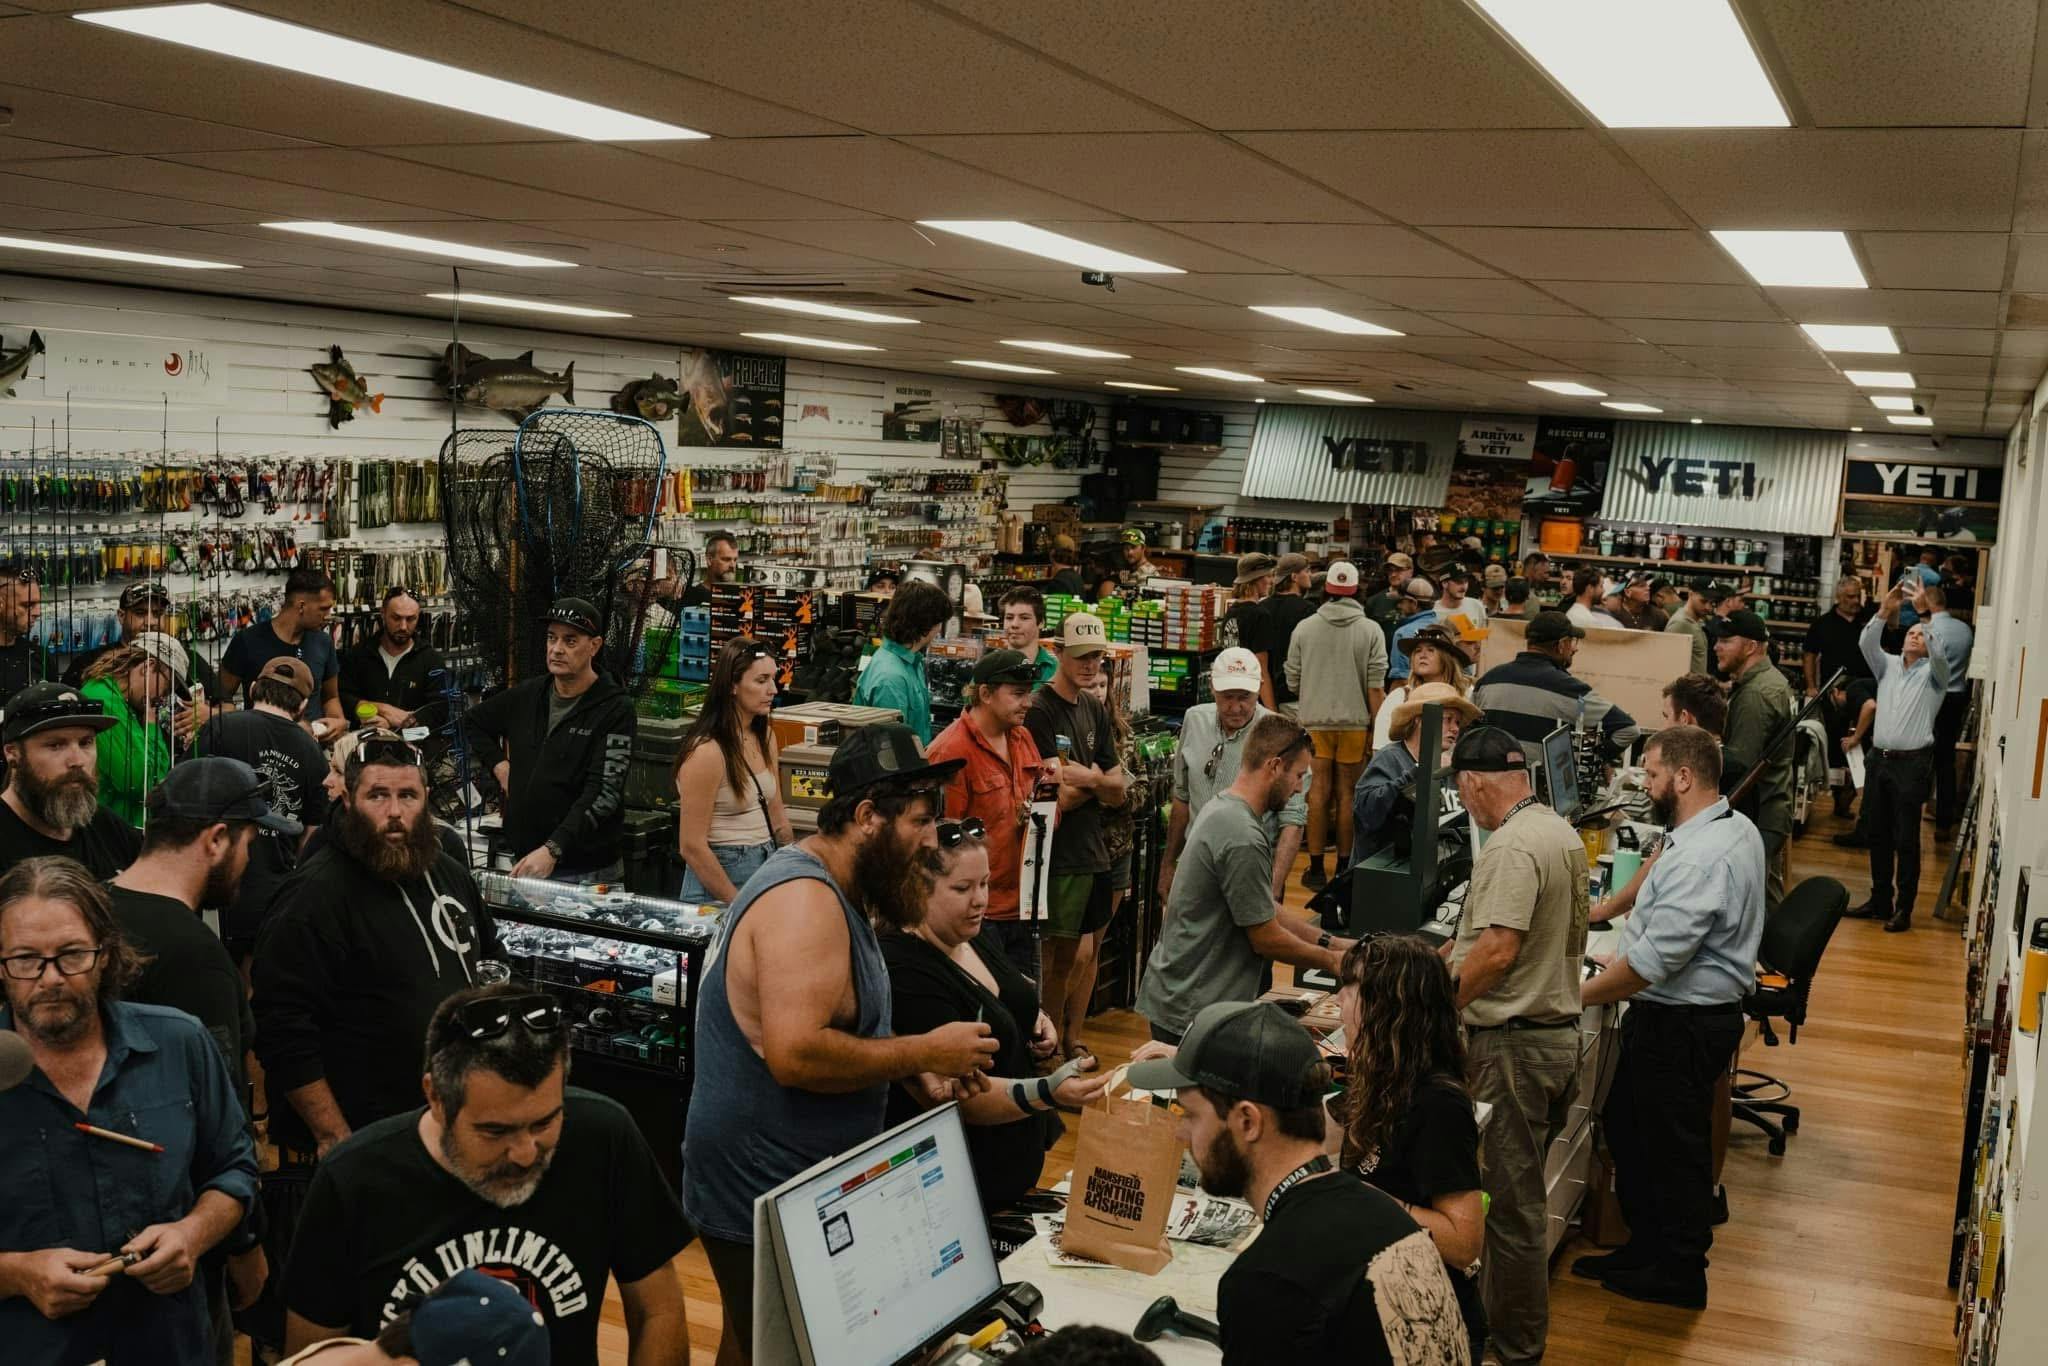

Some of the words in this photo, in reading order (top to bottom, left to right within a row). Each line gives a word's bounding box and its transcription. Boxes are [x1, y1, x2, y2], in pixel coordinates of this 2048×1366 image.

[1471, 430, 1525, 442] ARRIVAL
[1547, 429, 1584, 438] RESCUE
[1322, 435, 1426, 475] YETI
[1480, 445, 1511, 455] YETI
[1640, 456, 1756, 500] YETI
[1875, 463, 1979, 499] YETI
[1075, 623, 1102, 636] CTC
[1087, 1175, 1146, 1207] HUNTING
[1094, 1166, 1142, 1190] MANSFIELD
[1278, 1166, 1309, 1193] EVENT
[435, 1226, 588, 1318] UNLIMITED
